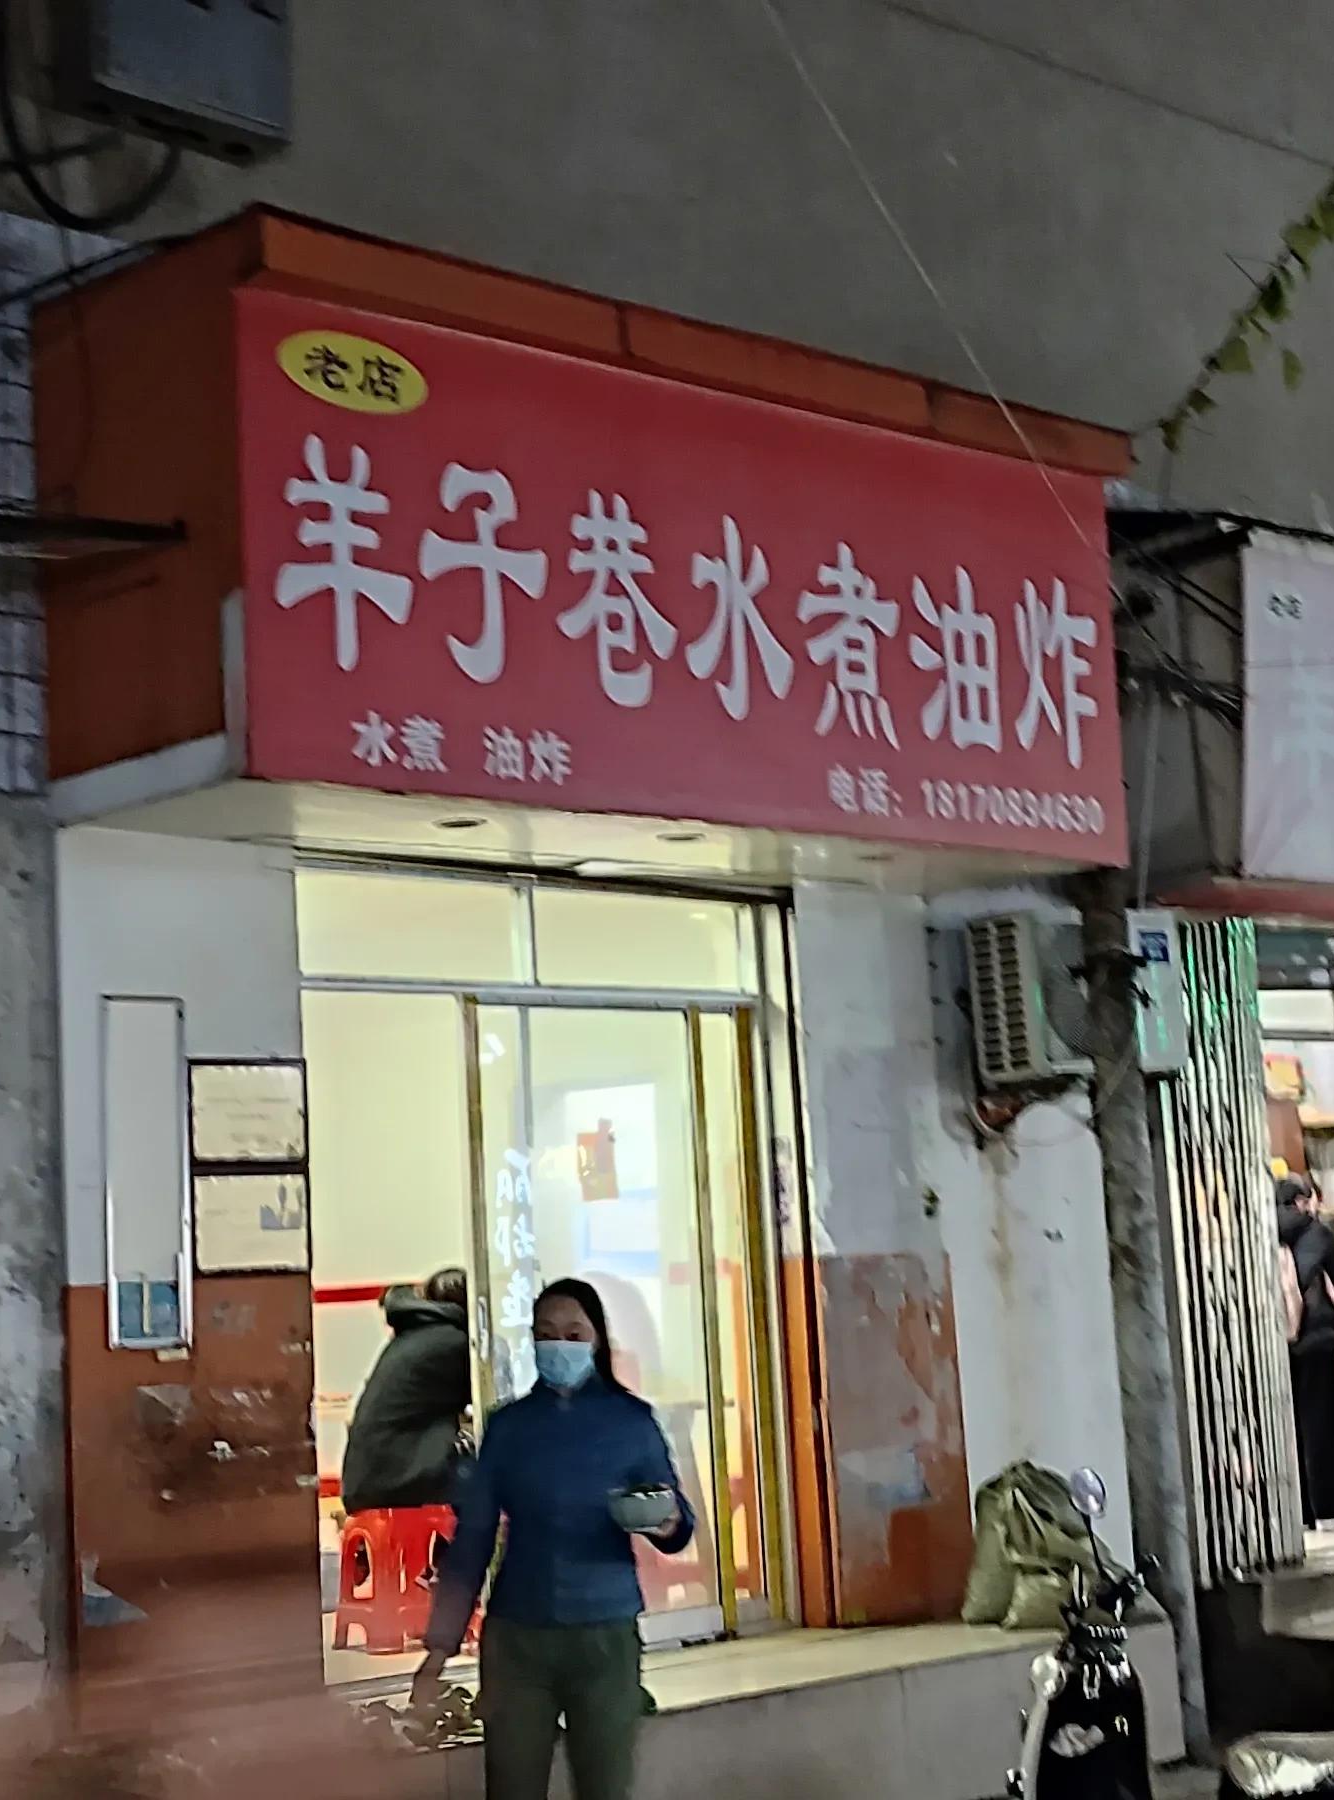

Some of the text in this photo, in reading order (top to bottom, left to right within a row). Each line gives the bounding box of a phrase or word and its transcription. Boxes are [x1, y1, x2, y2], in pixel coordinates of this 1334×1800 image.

[304, 344, 404, 405] 老店
[275, 433, 1098, 770] 羊子巷水煮油炸
[350, 709, 572, 786] 水煮 油炸
